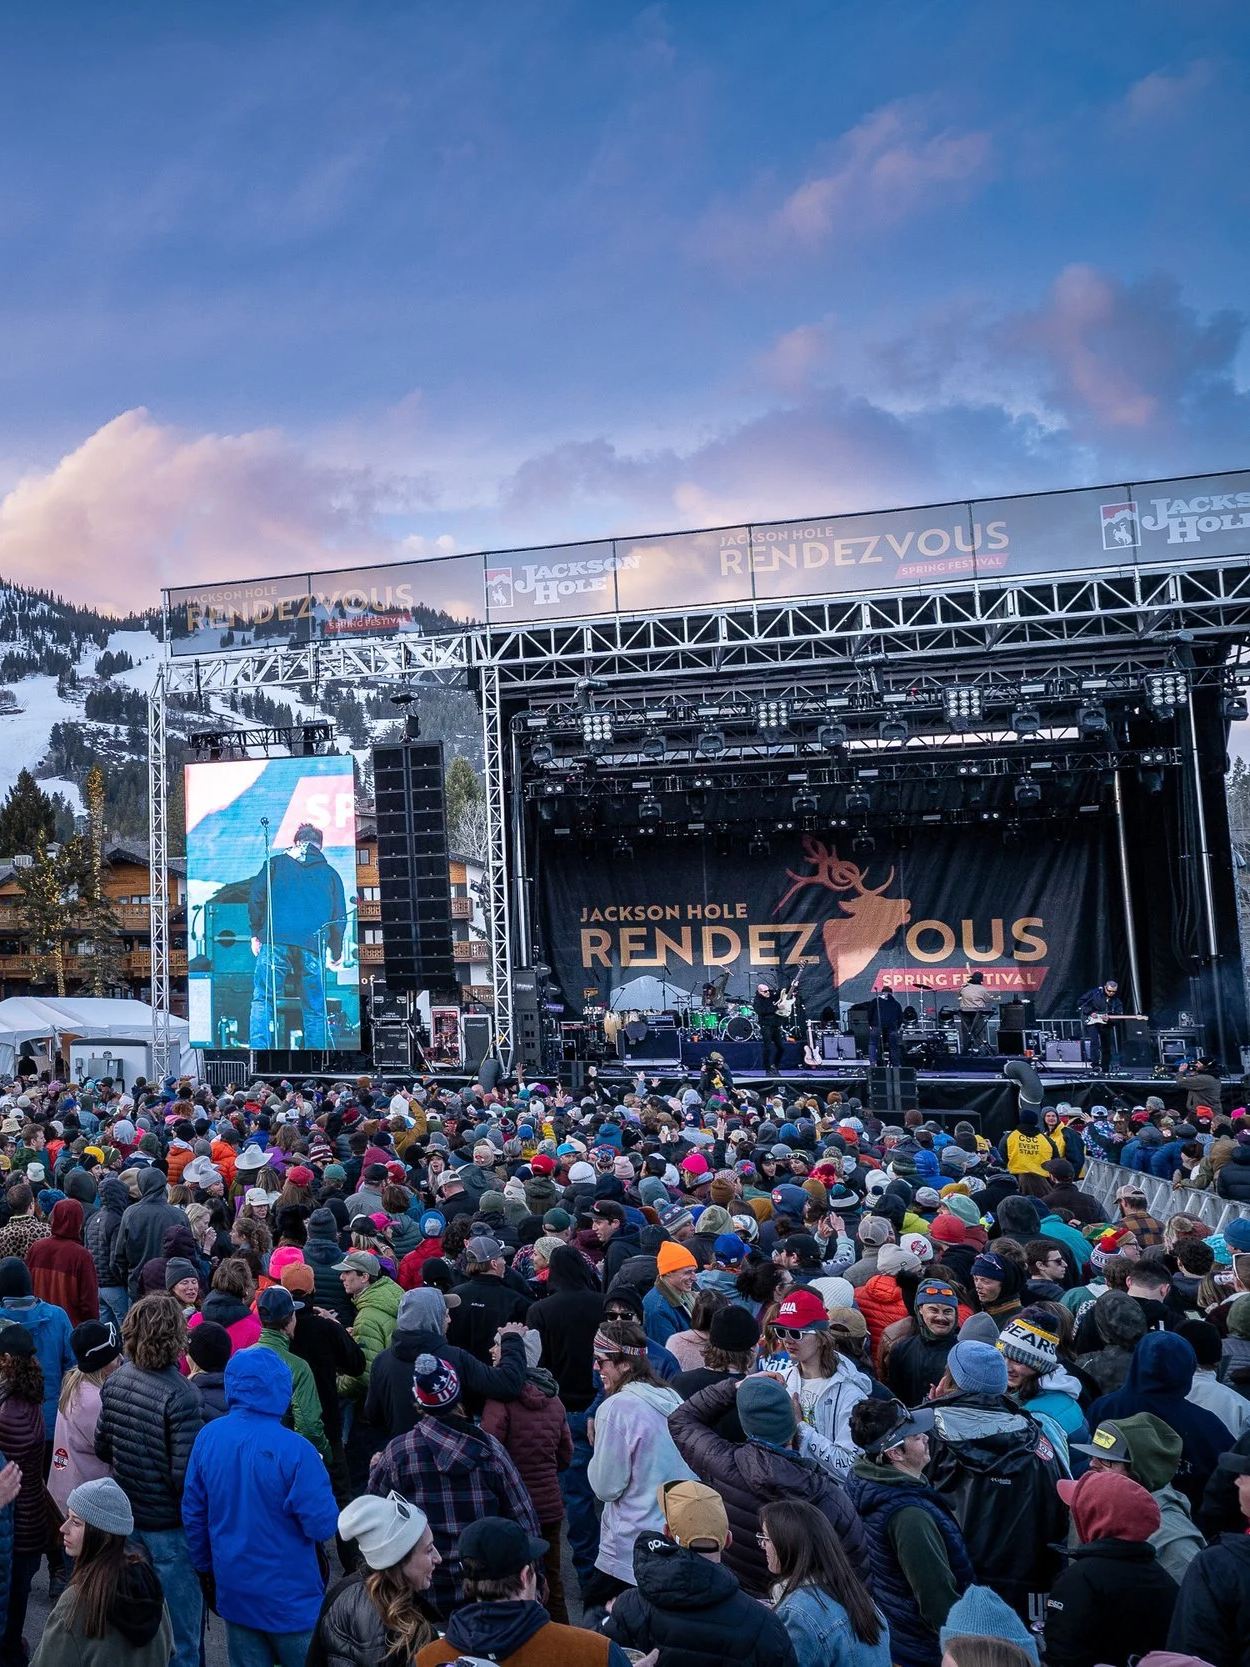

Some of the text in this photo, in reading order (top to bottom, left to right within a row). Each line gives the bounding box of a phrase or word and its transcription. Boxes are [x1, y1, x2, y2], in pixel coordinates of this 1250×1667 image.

[720, 526, 834, 547] JACKSON HOLE
[1167, 512, 1250, 544] HOL
[720, 521, 1009, 576] RENDEZVOUS
[514, 555, 642, 594] JACKSON
[901, 556, 1003, 576] SPRING FESTIVAL
[187, 585, 278, 604] JACKSON HOLE
[533, 576, 607, 605] HOLE
[187, 583, 414, 632] RENDEZVOUS
[328, 615, 410, 631] SPRING FESTIVAL
[580, 903, 748, 922] JACKSON HOLE
[882, 973, 1037, 987] SPRING FETIVAL
[1018, 1134, 1038, 1144] CSC
[1018, 1142, 1040, 1150] EVENT
[1019, 1148, 1039, 1156] STAFF
[1003, 1321, 1056, 1356] BEARS
